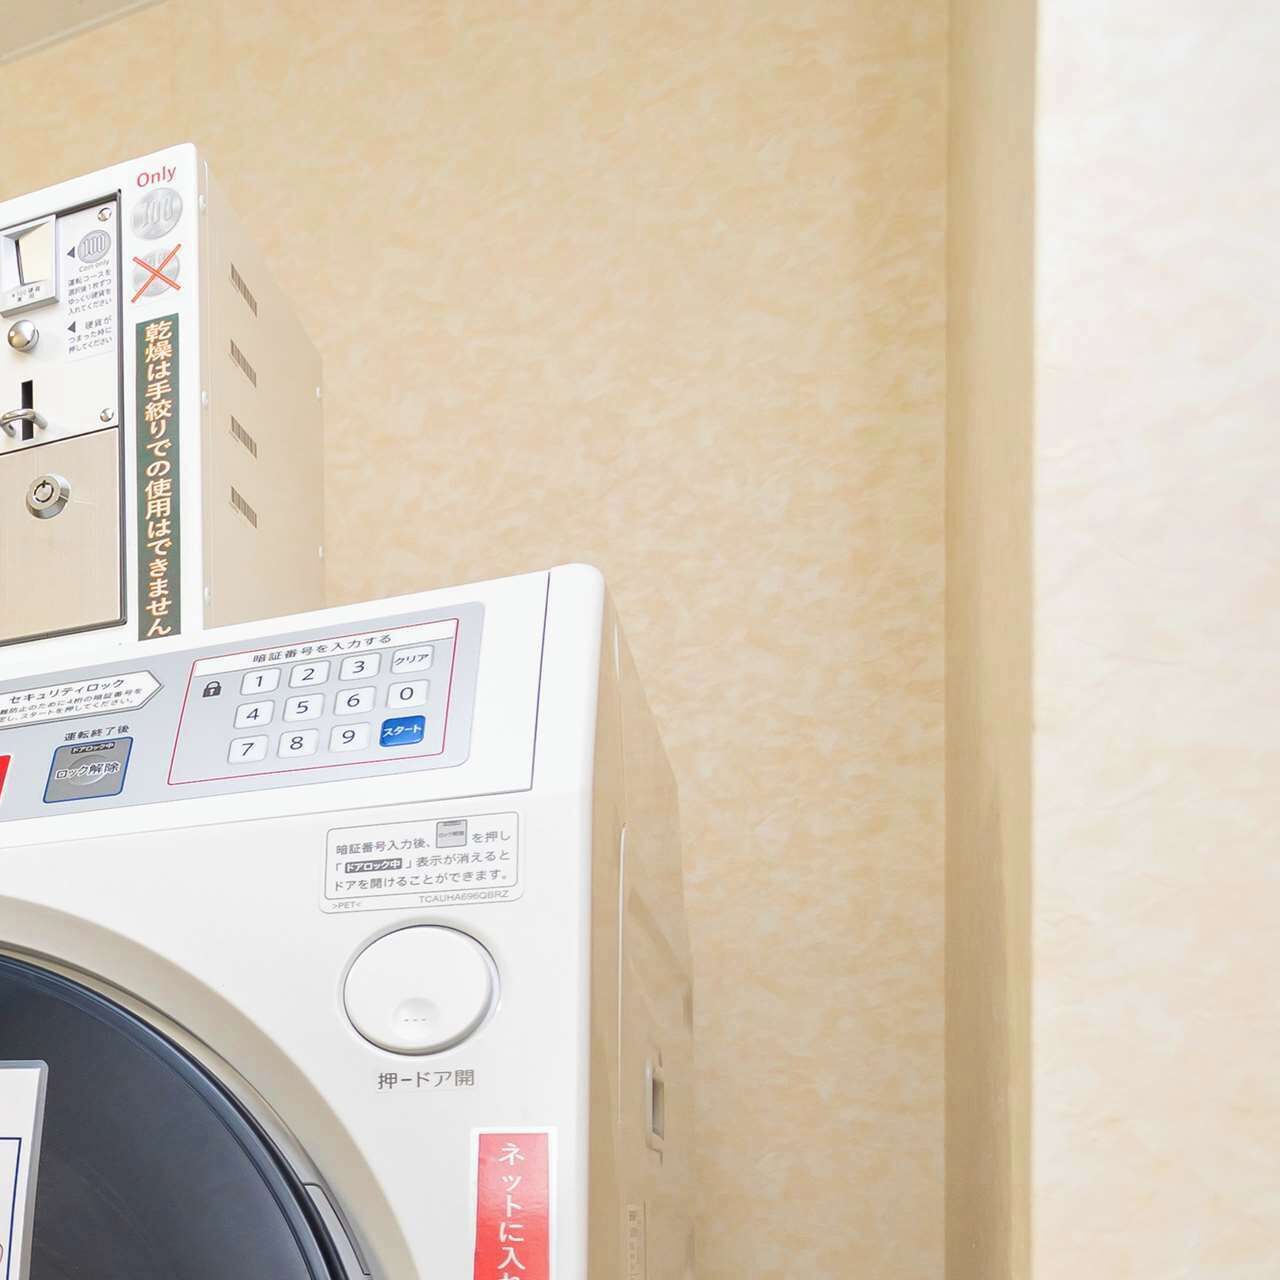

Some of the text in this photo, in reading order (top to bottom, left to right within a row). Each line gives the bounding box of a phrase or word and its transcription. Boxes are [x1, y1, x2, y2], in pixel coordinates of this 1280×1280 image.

[137, 166, 177, 188] Only
[145, 319, 172, 637] 乾燥は手絞りでの使用はできません
[252, 634, 392, 663] 暗証番号を入力する
[353, 661, 365, 673] 3
[394, 653, 429, 667] クリア
[256, 675, 264, 688] 1
[302, 668, 315, 681] 2
[9, 679, 125, 704] セキュリティロック
[399, 687, 414, 701] 0
[296, 700, 309, 714] 5
[347, 693, 360, 707] 6
[246, 708, 259, 720] 4
[64, 725, 130, 742] 運転終了後
[342, 730, 355, 744] 9
[383, 724, 421, 737] スタート
[242, 743, 254, 756] 7
[290, 736, 303, 750] 8
[55, 762, 120, 779] ロック解除
[334, 869, 508, 891] ドアを開けることができます。
